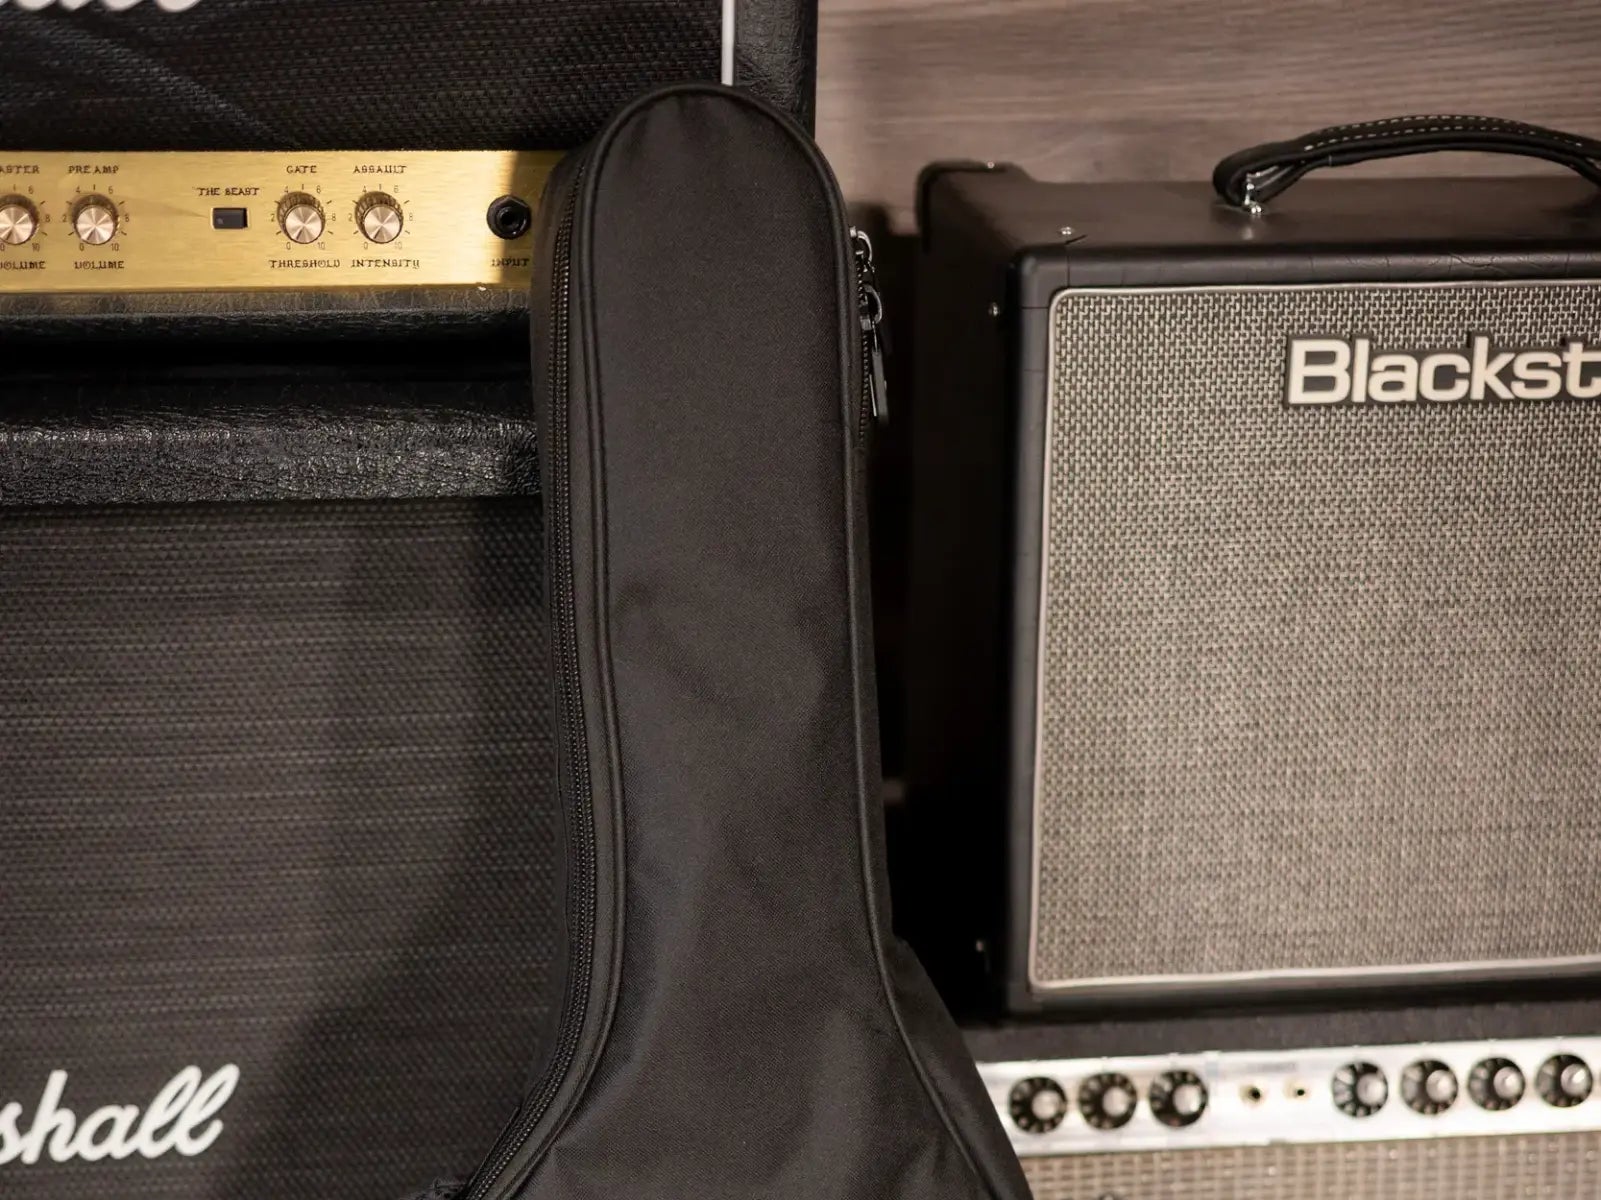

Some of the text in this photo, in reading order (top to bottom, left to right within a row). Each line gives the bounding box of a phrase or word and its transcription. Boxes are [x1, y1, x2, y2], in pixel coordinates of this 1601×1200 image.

[286, 165, 318, 174] GATE
[353, 165, 407, 174] ASSAULT
[197, 187, 260, 196] THE BEAST
[111, 243, 120, 252] 10
[317, 242, 326, 250] 10
[74, 261, 125, 270] VOLUME
[268, 259, 341, 269] THRESHOLD
[351, 259, 420, 270] INTENSITY
[490, 258, 530, 267] INPUT
[1288, 336, 1601, 404] Blackst
